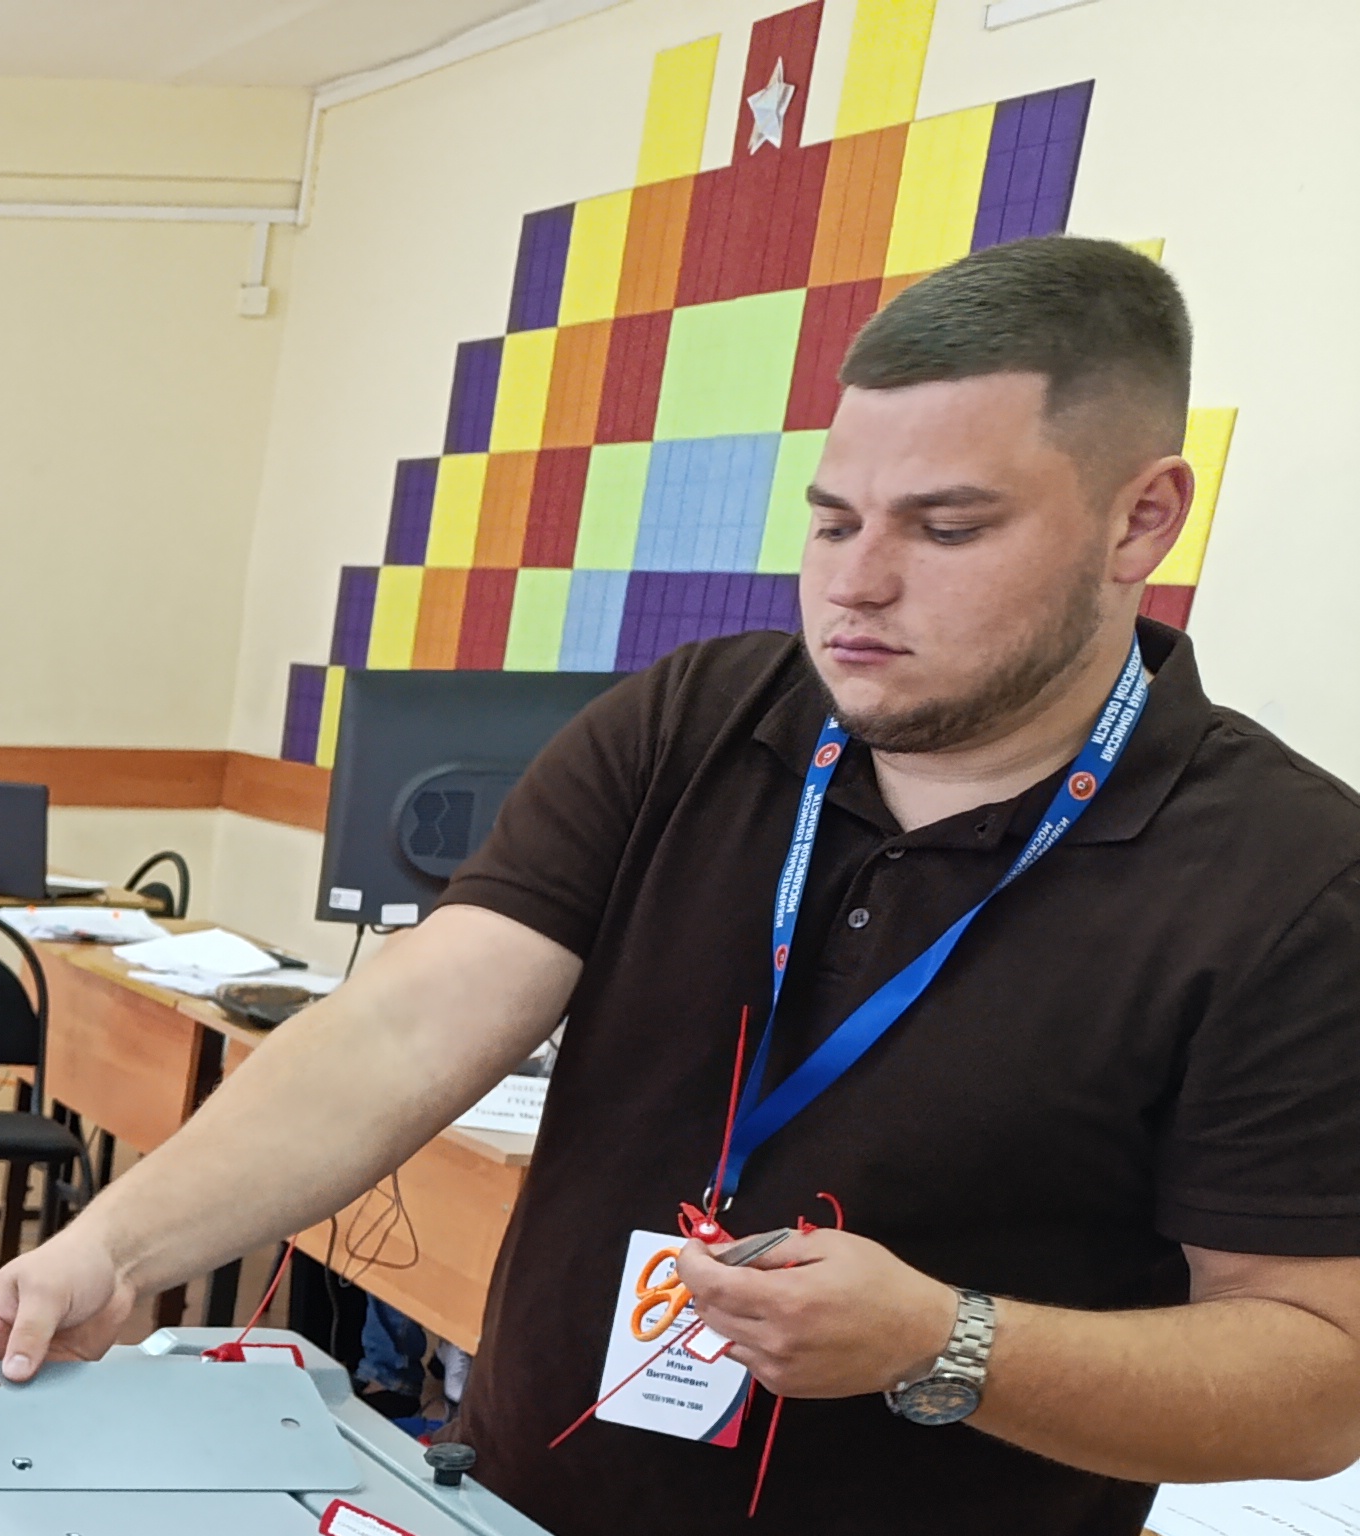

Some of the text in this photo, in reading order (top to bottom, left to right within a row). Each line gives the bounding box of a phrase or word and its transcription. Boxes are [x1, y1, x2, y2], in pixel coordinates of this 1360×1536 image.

[1091, 697, 1121, 745] ОБЛАСТИ
[1100, 702, 1137, 762] КОМИССИЯ
[776, 784, 816, 928] ИЗБИРАТЕЛЬНАЯ КОМИССИЯ
[786, 793, 822, 913] МОСКОВСКОЙ ОБЛАСТИ
[646, 1369, 708, 1387] Витальевич
[666, 1360, 693, 1371] Илья
